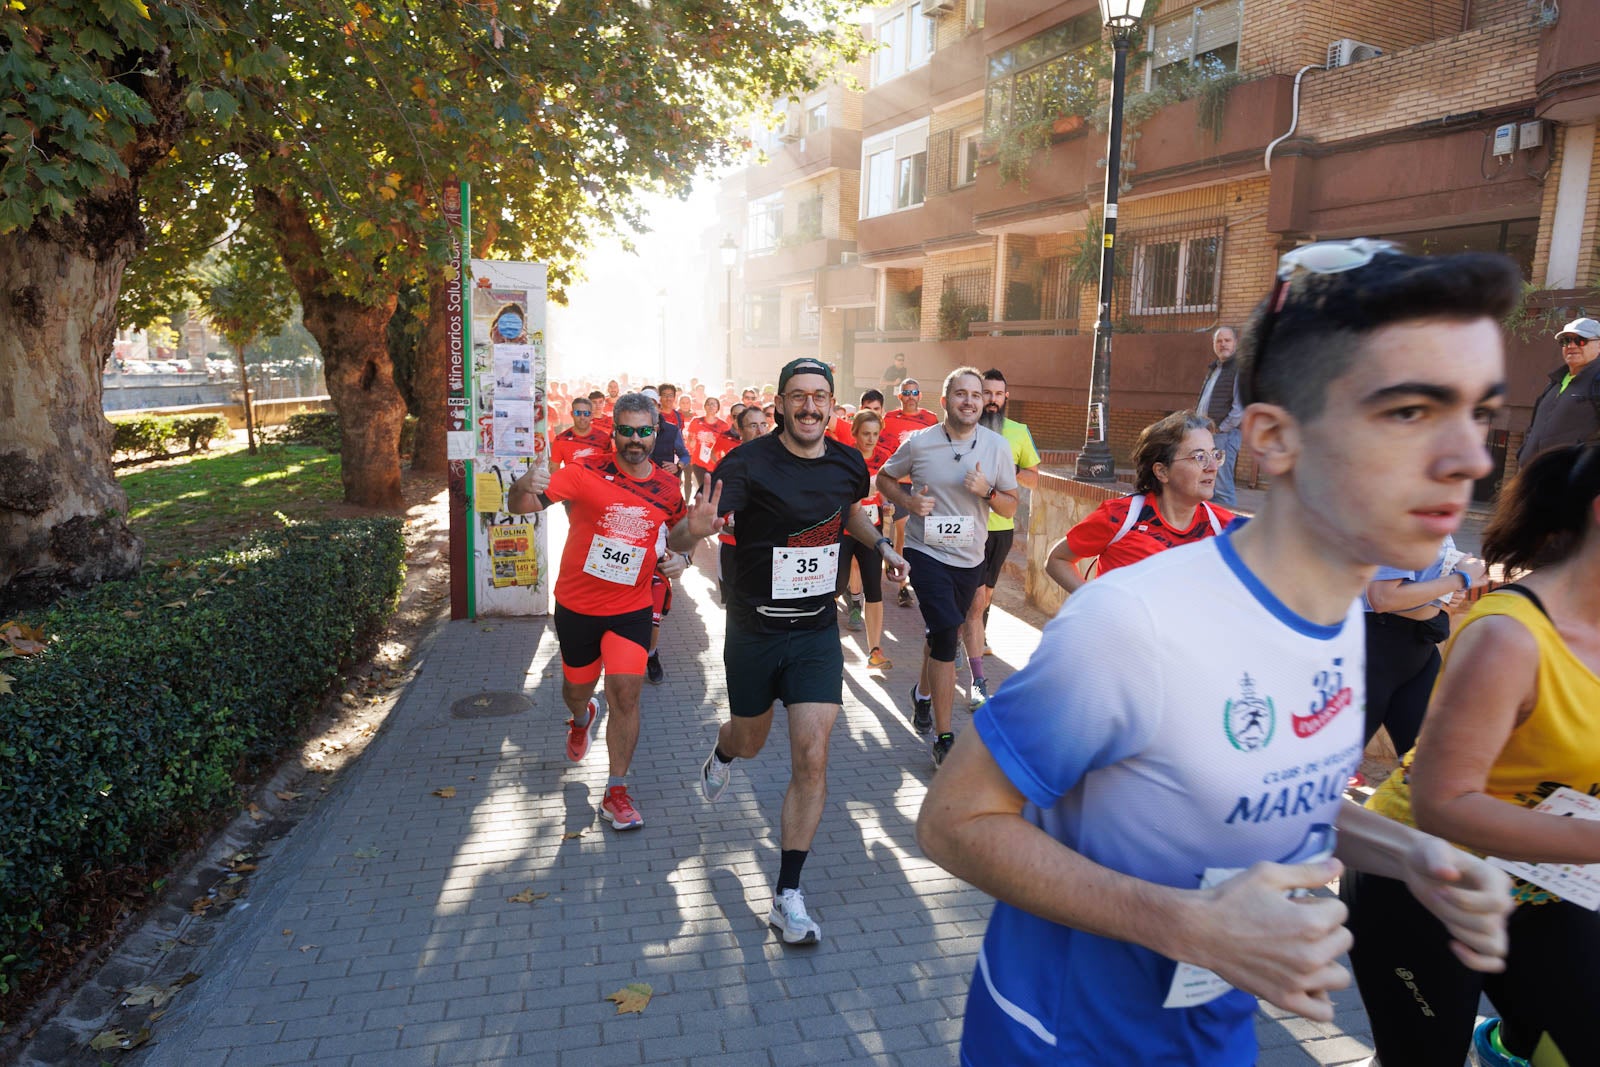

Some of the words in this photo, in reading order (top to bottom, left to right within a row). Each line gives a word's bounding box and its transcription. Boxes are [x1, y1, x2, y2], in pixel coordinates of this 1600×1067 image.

[937, 523, 961, 534] 122
[602, 547, 631, 565] 546
[796, 558, 818, 574] 35
[804, 574, 824, 582] MORALES
